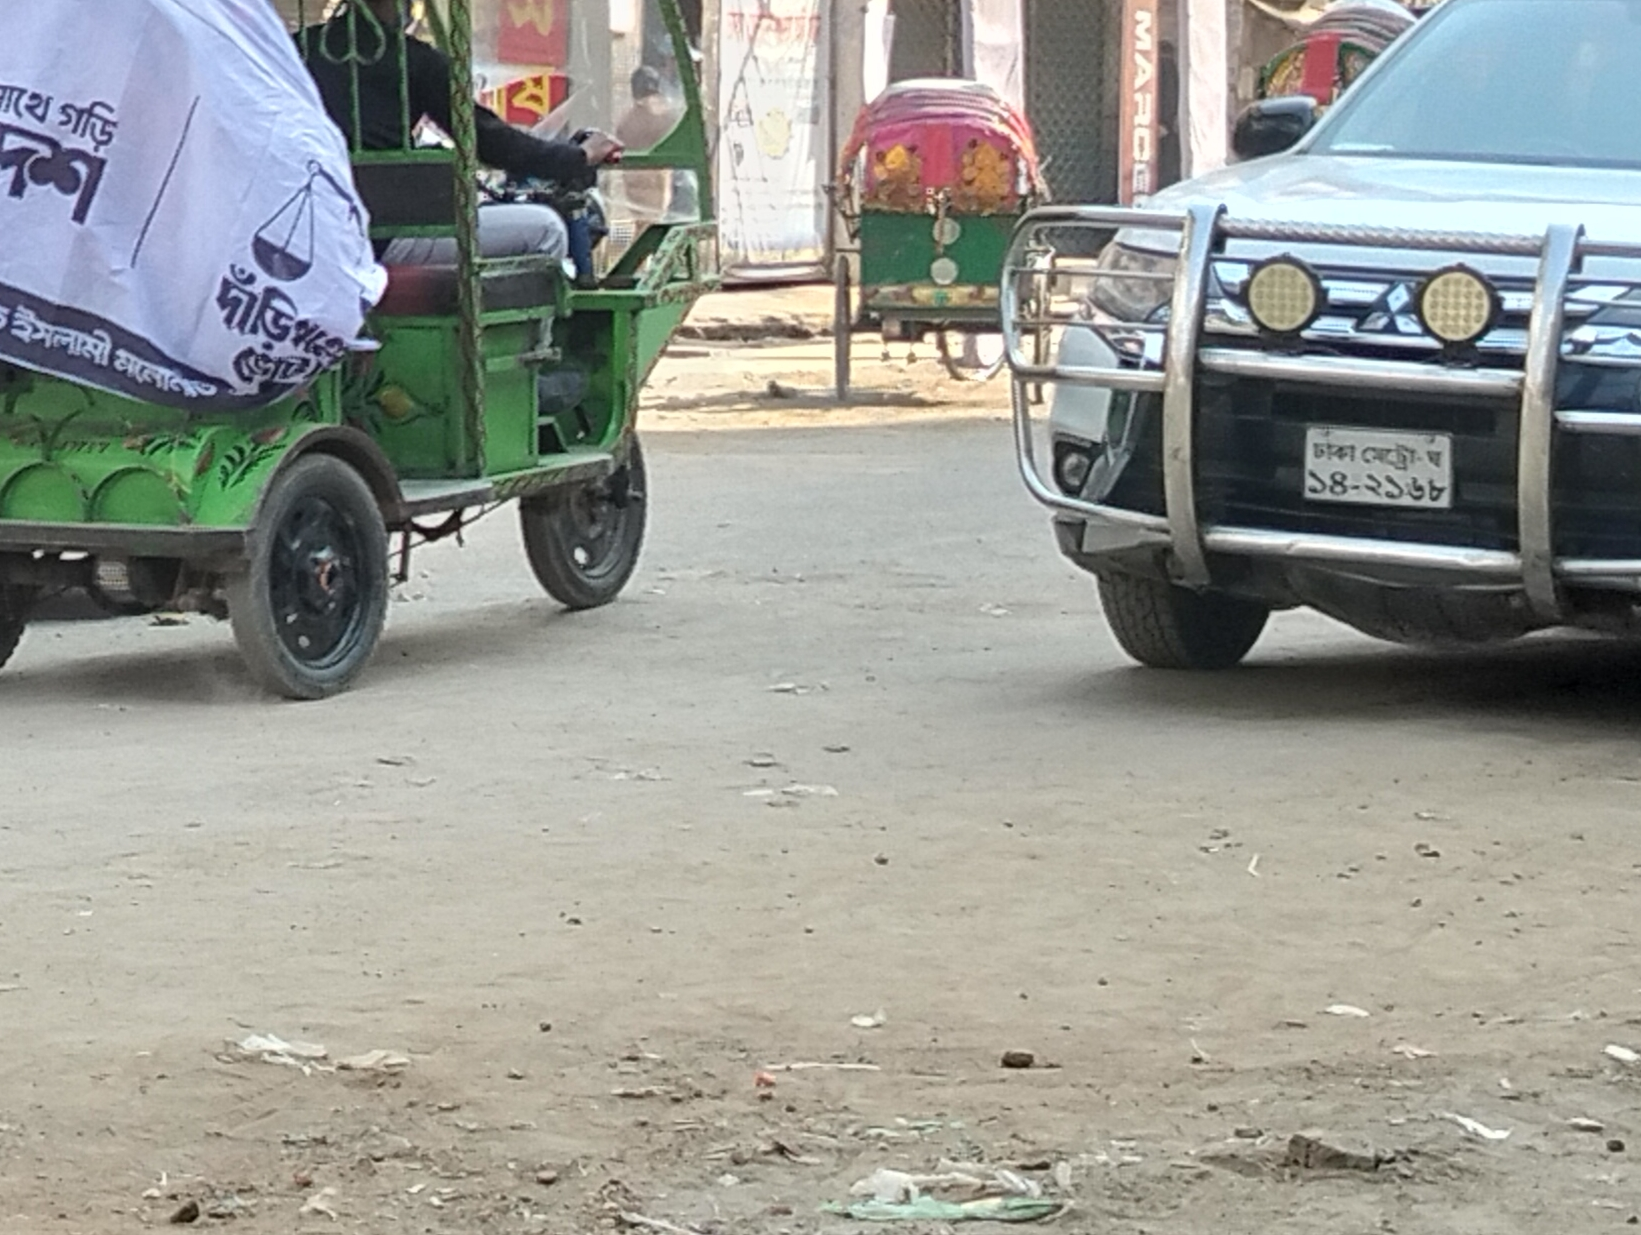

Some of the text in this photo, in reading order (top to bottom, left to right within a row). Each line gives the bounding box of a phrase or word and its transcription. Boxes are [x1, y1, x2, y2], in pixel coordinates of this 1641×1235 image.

[58, 100, 118, 153] গড়ি
[1133, 10, 1154, 196] MARCE
[10, 305, 113, 367] ইসলামী
[1313, 442, 1356, 462] ঢাকা
[1308, 470, 1448, 502] ১৪-২১৬৮
